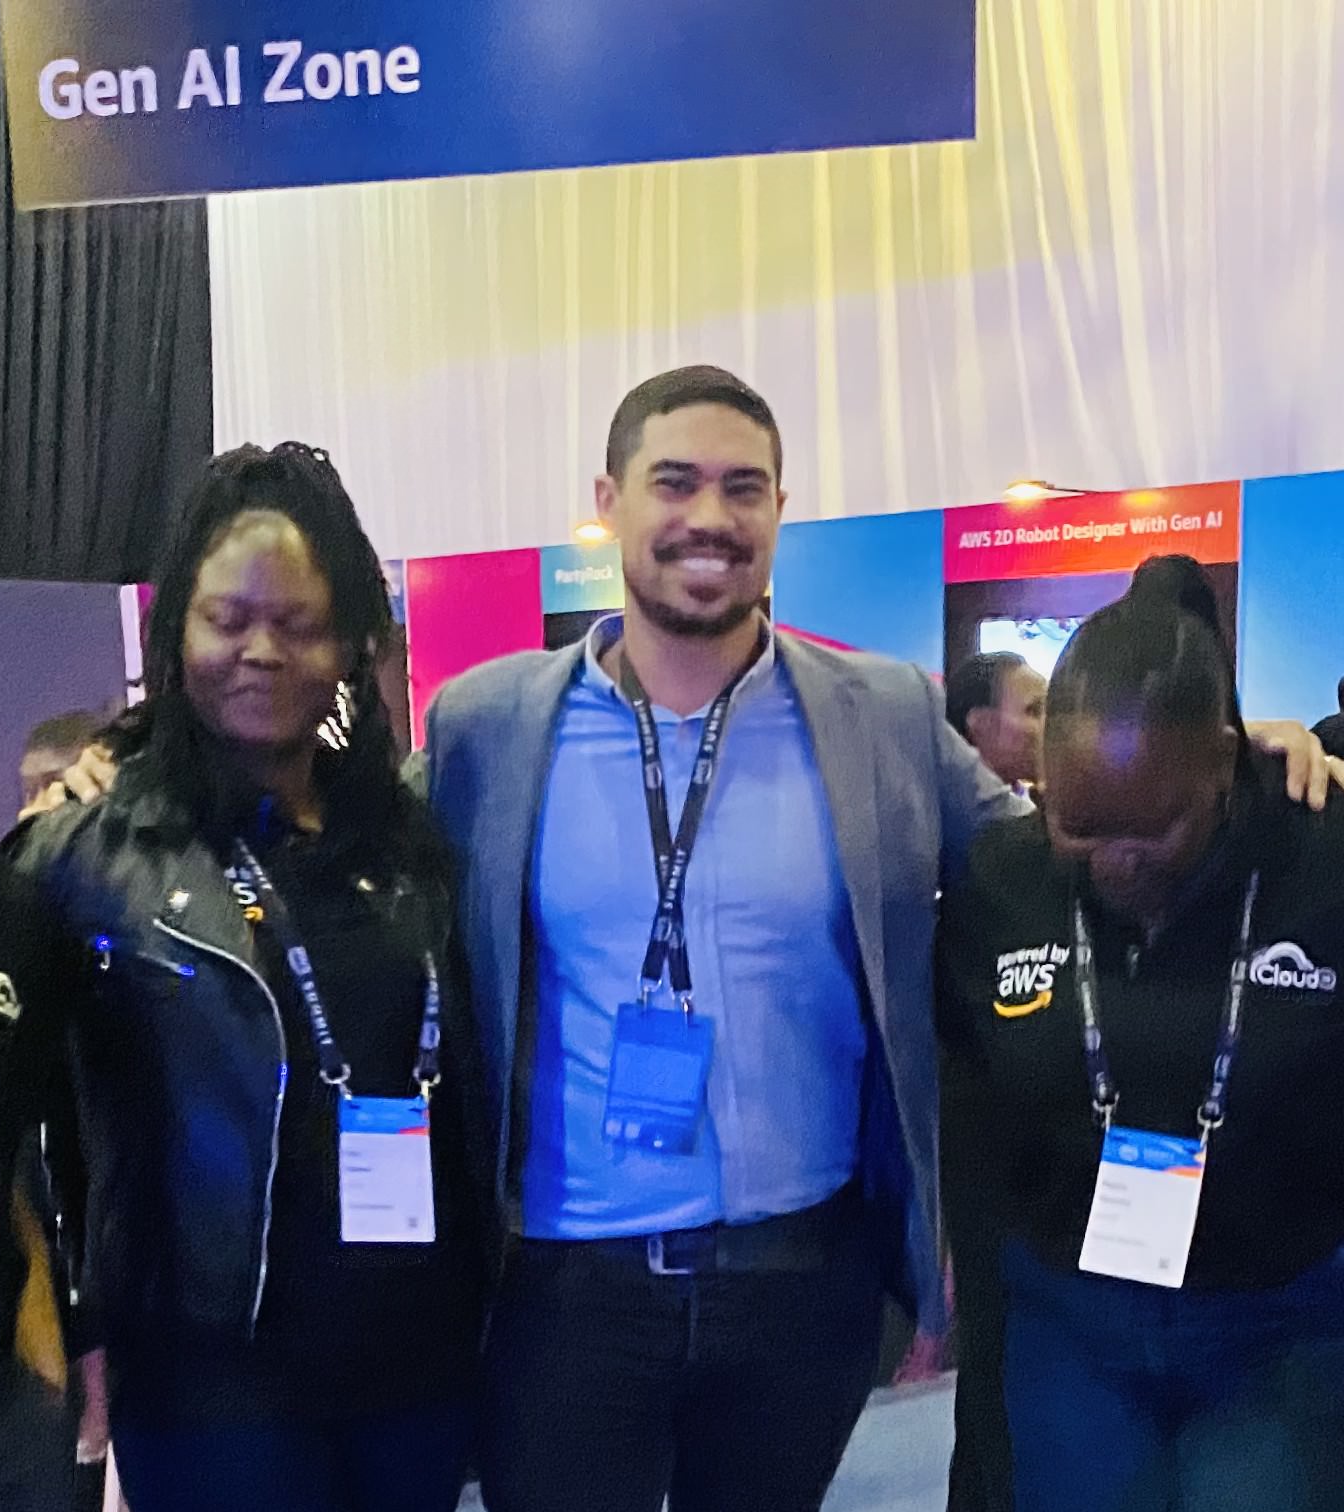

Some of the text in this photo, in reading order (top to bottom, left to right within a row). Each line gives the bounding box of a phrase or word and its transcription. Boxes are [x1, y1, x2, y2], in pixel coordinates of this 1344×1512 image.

[38, 40, 421, 120] Gen AI Zone
[959, 511, 1223, 548] AWS 2D Robot Designer With Gen AI
[1050, 942, 1071, 966] by
[998, 962, 1056, 998] aws
[302, 980, 334, 1045] SUMMIT
